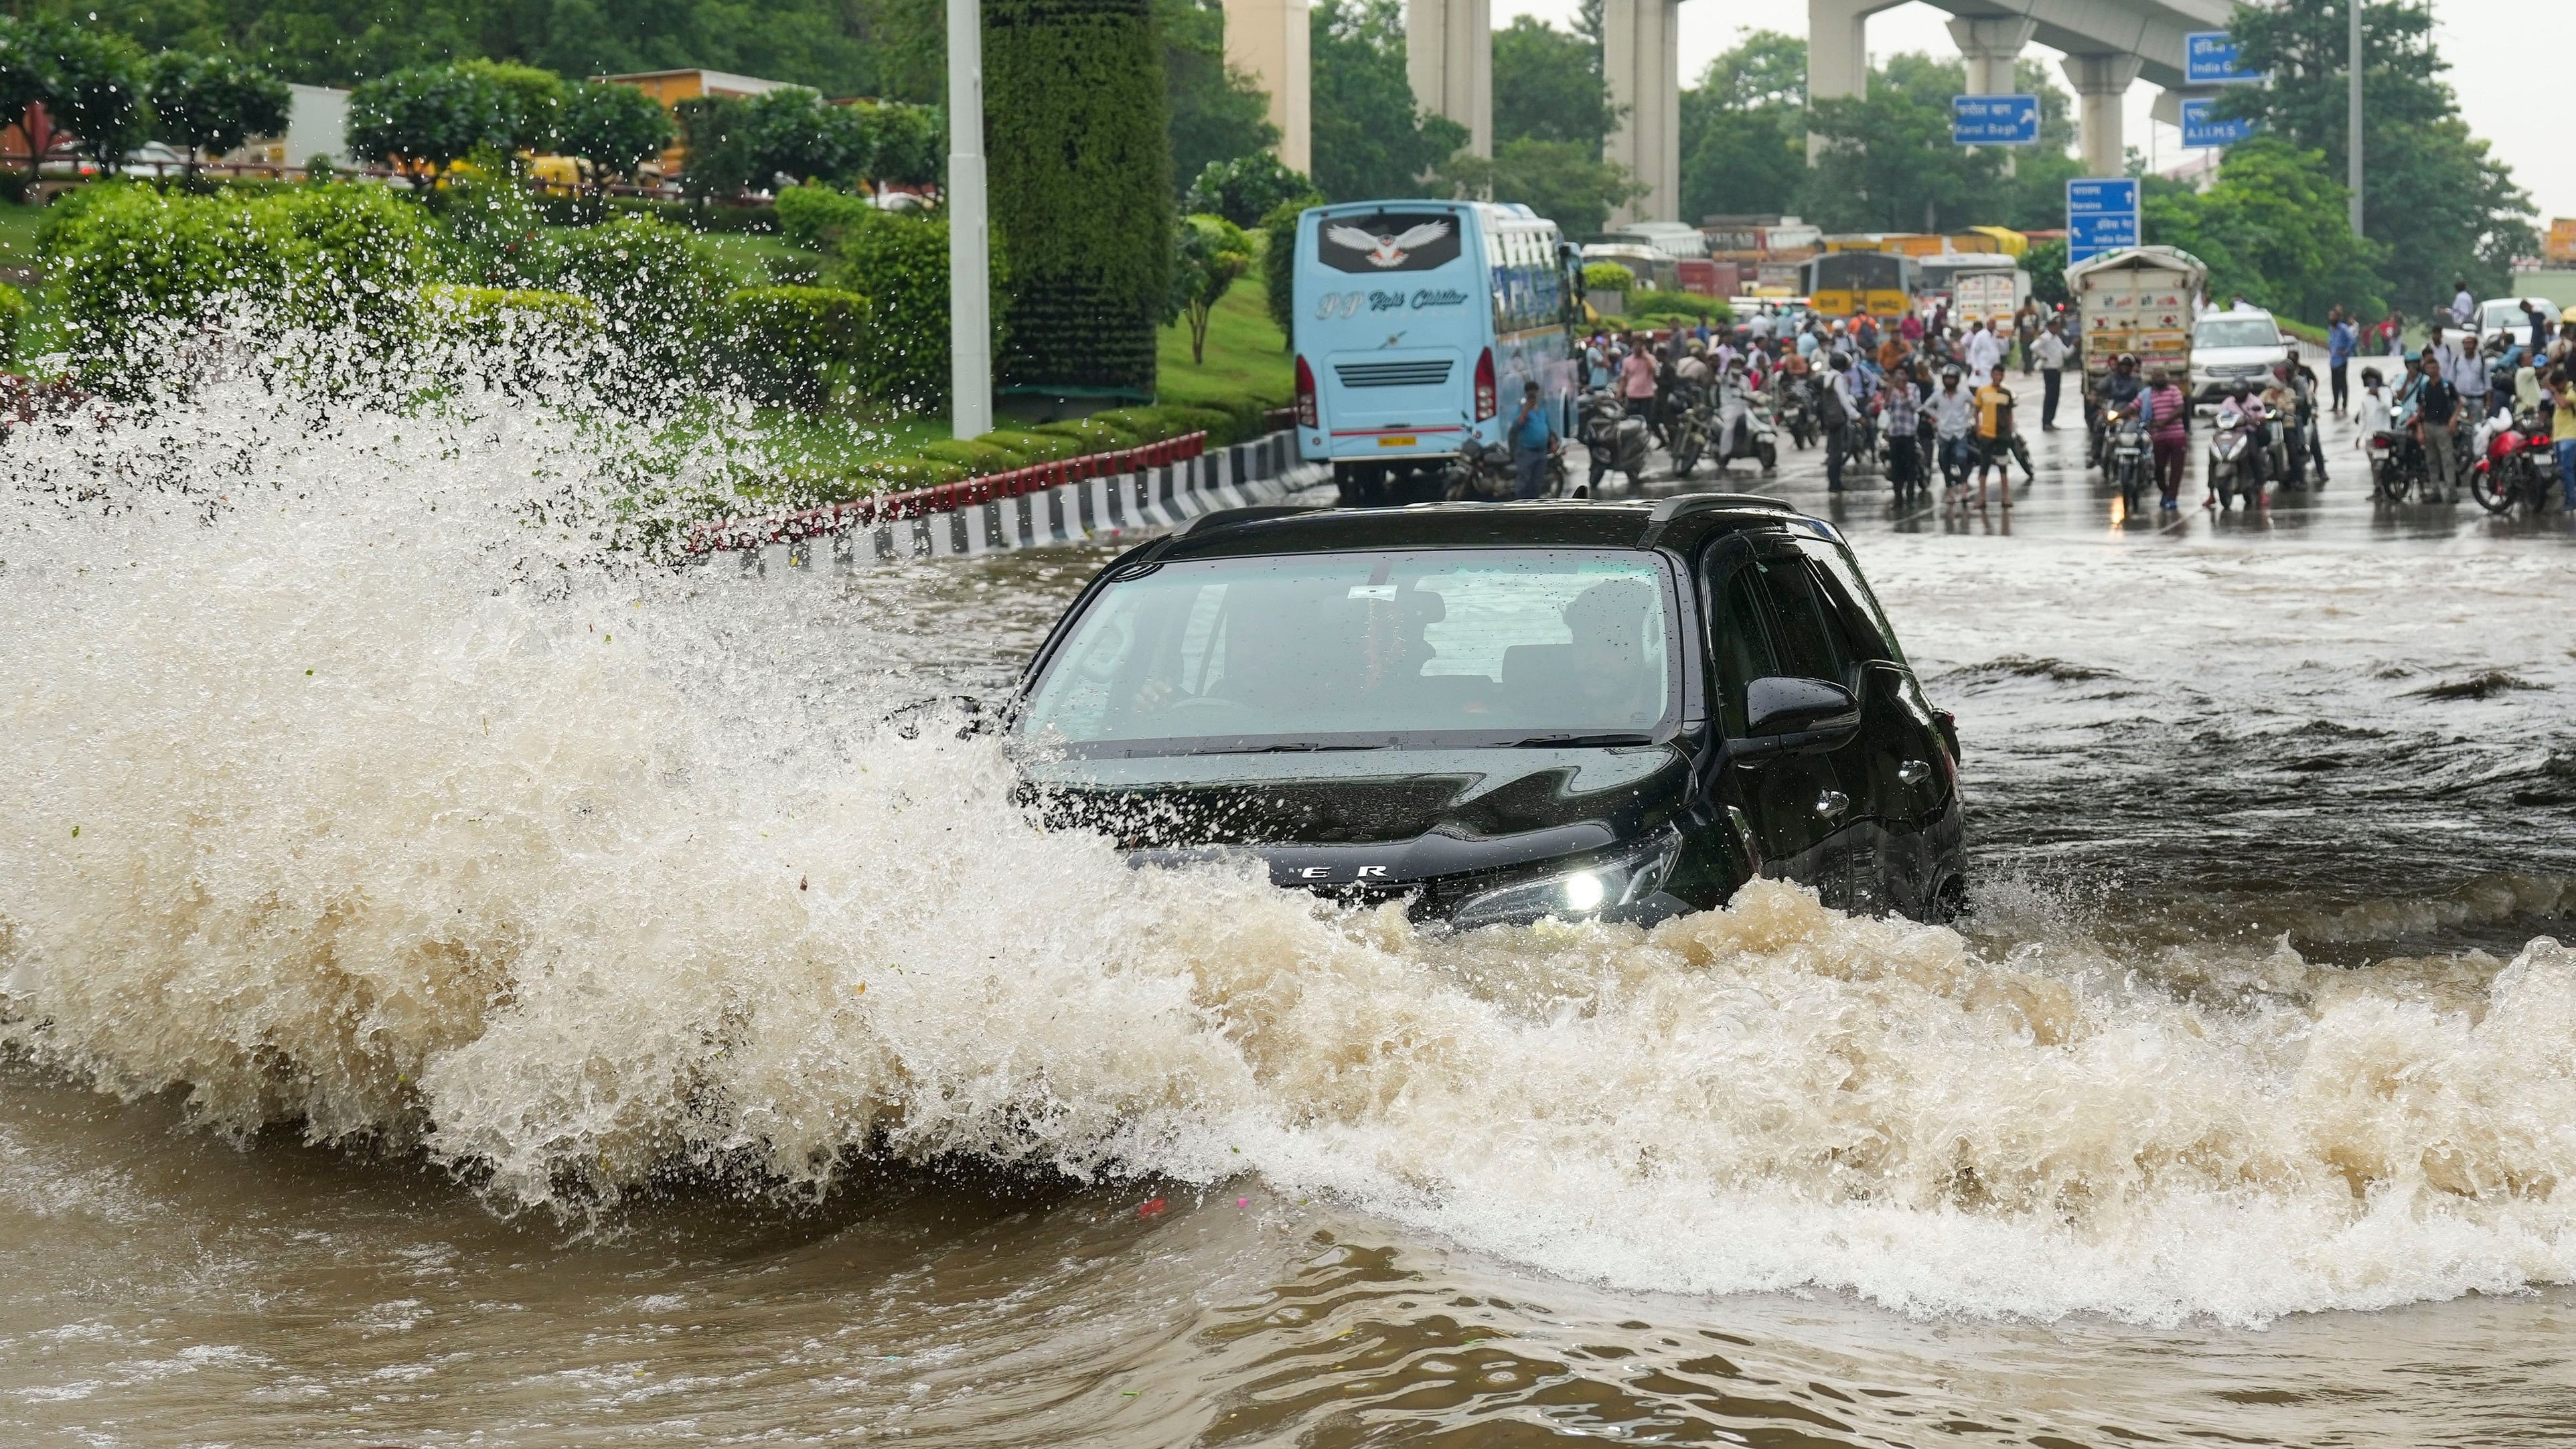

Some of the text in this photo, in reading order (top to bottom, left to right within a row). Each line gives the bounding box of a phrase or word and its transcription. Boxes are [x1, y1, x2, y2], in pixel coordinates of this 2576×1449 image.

[2192, 61, 2221, 73] India
[1955, 123, 2018, 137] Karol Bagh
[2093, 234, 2114, 244] India
